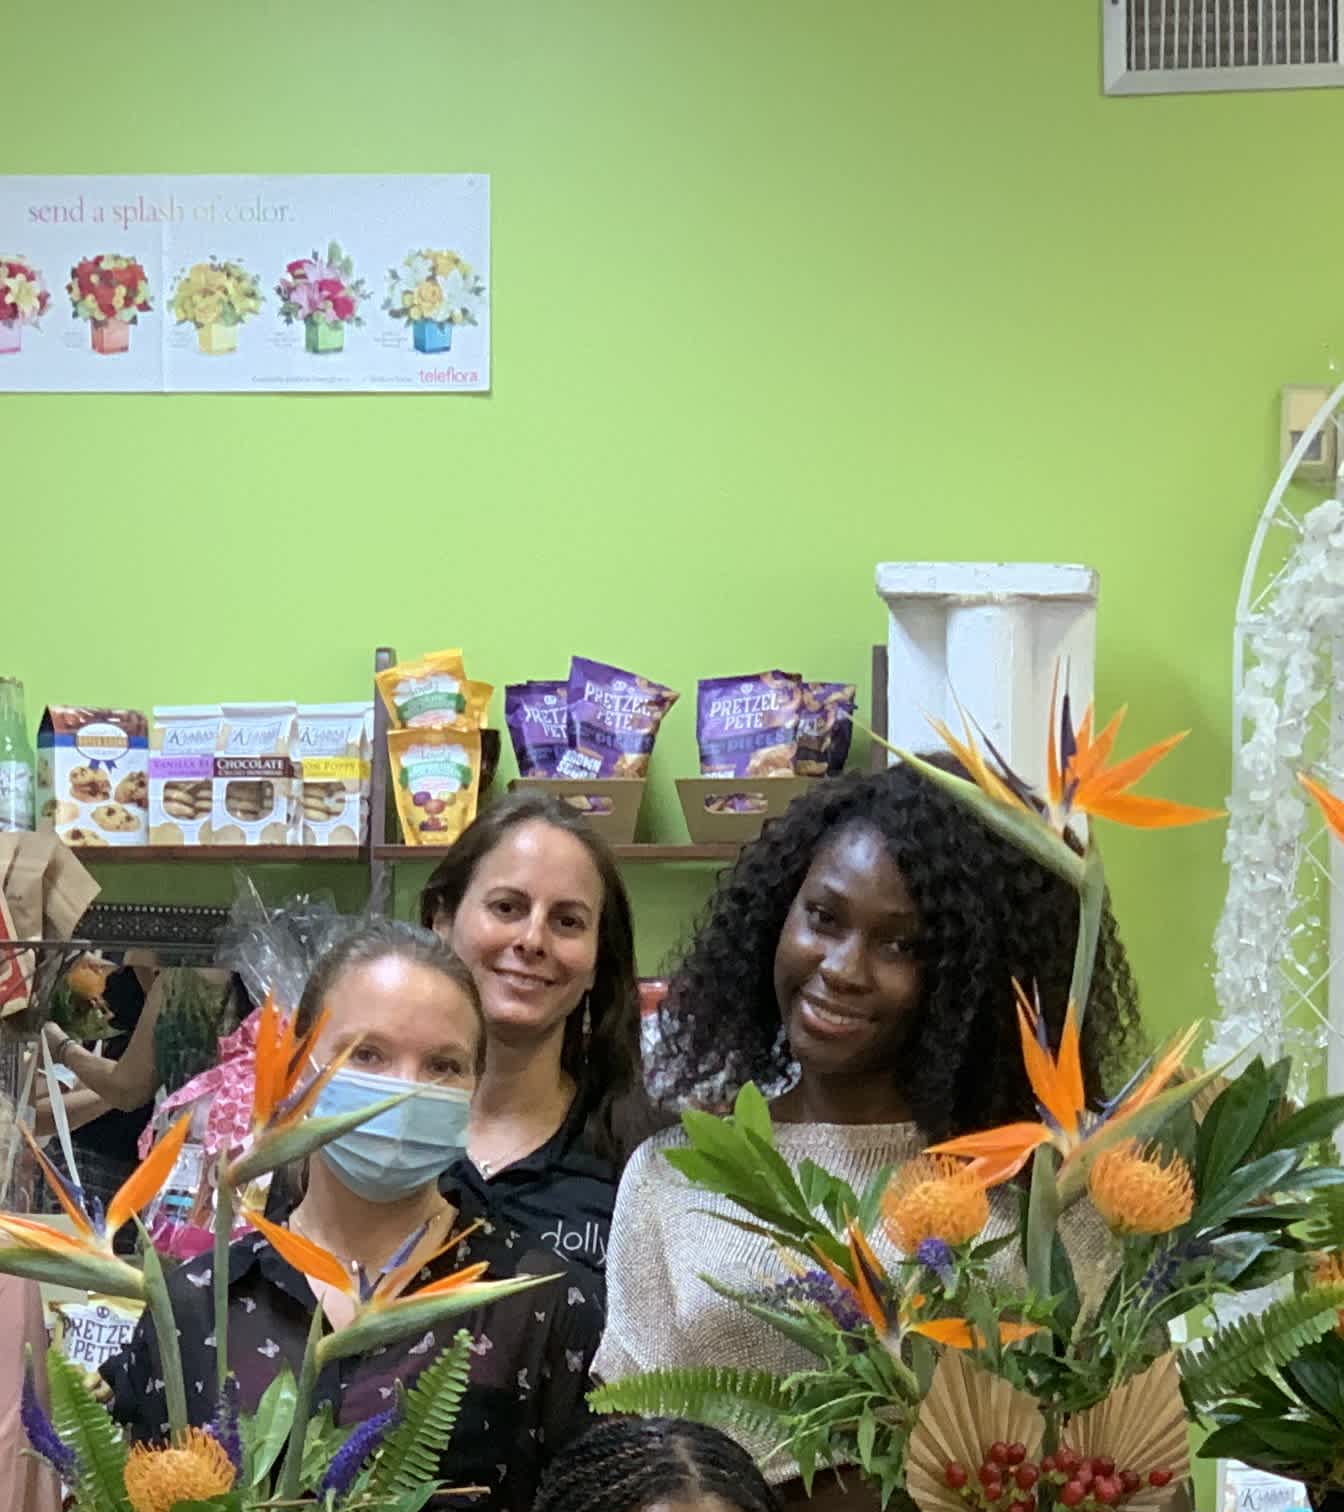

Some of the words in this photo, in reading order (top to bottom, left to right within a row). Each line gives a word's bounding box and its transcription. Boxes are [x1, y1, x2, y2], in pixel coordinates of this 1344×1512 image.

[27, 196, 84, 223] send
[92, 202, 105, 223] a
[112, 195, 185, 230] splash
[193, 194, 222, 223] of
[225, 195, 295, 223] color.
[419, 367, 478, 384] teleflora
[584, 680, 651, 717] PRETZEL
[710, 692, 780, 718] PRETZEL
[523, 703, 568, 724] PRETZ
[597, 708, 633, 731] PETE
[724, 713, 763, 731] PETE
[543, 725, 568, 739] PET
[217, 758, 284, 770] CHOCOLATE
[540, 1219, 607, 1265] dolly
[62, 1316, 131, 1345] PRETZE
